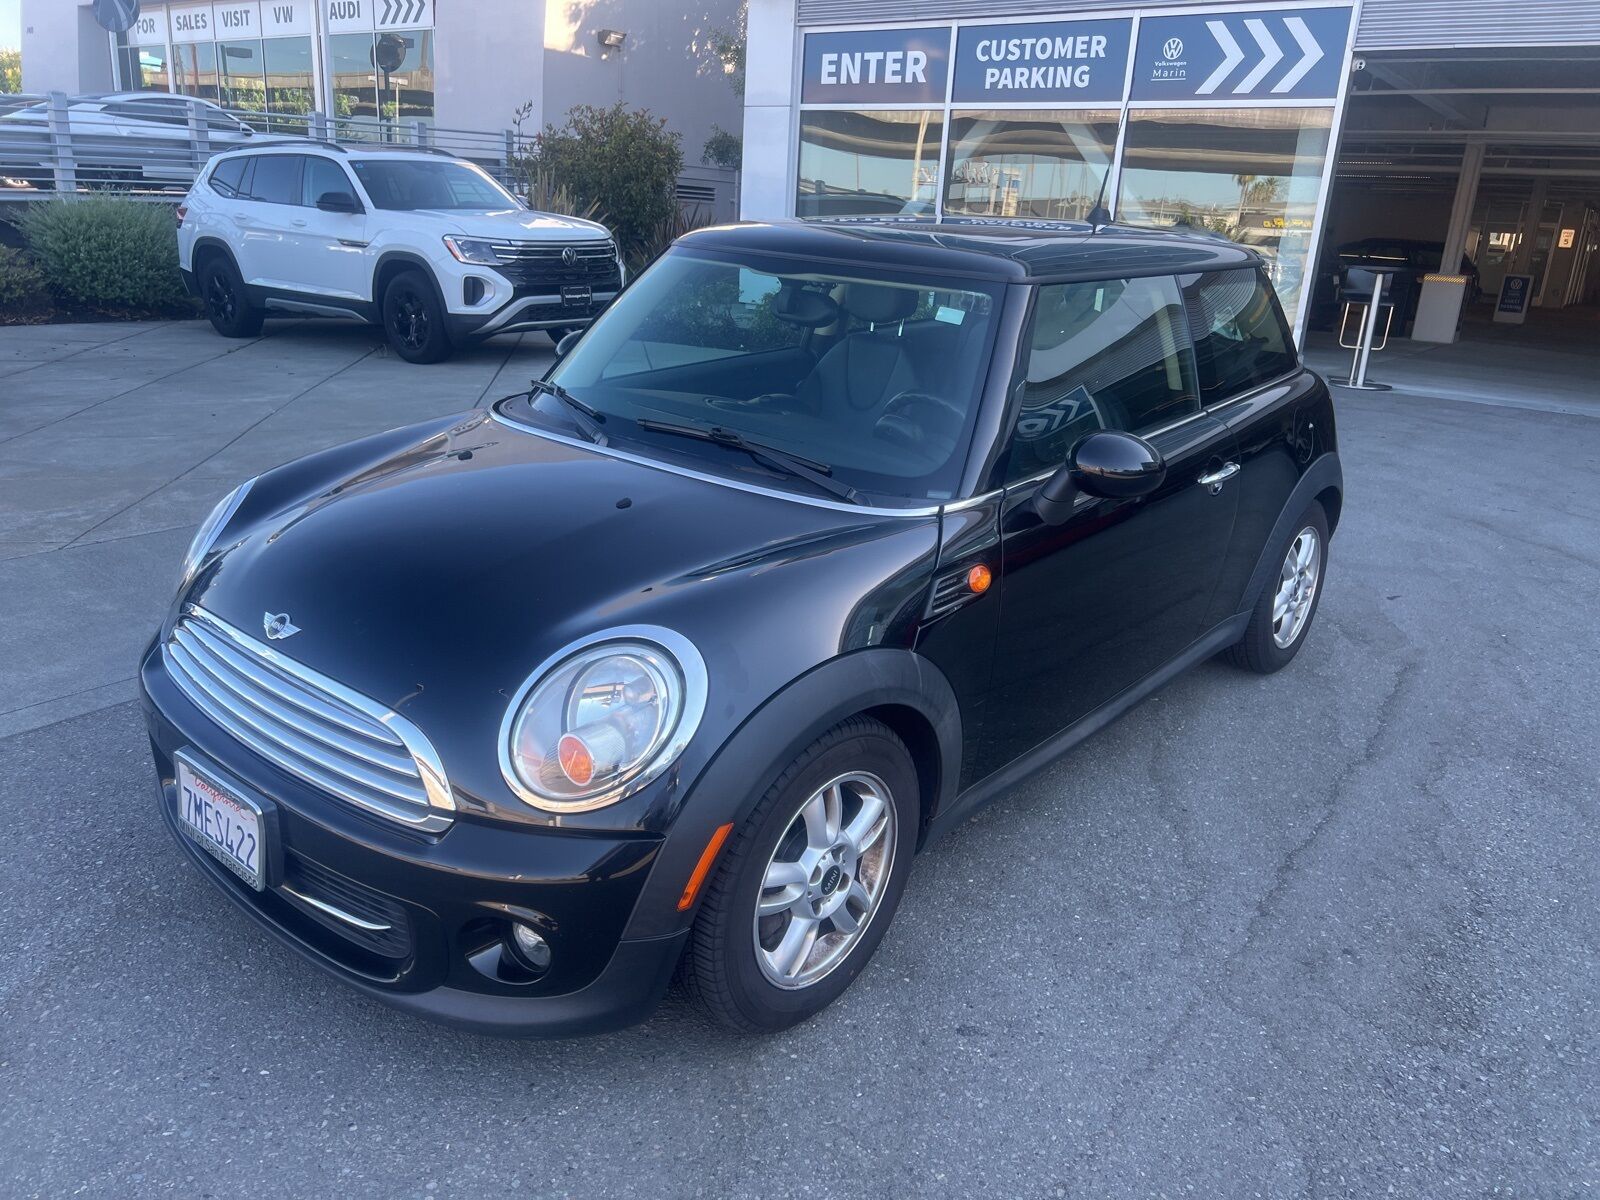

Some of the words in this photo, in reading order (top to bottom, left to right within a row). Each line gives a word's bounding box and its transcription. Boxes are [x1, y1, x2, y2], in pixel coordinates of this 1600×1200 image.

[136, 18, 155, 34] FOR
[176, 13, 207, 31] SALES
[222, 9, 250, 27] VISIT
[273, 6, 293, 23] VW
[329, 0, 361, 20] AUDI
[976, 35, 1107, 62] CUSTOMER
[820, 50, 927, 85] ENTER
[984, 65, 1090, 90] PARKING
[1152, 68, 1186, 77] Marin
[183, 786, 256, 873] 7MES422
[205, 840, 219, 858] San
[221, 853, 258, 887] Francisco
[825, 870, 838, 892] MINI
